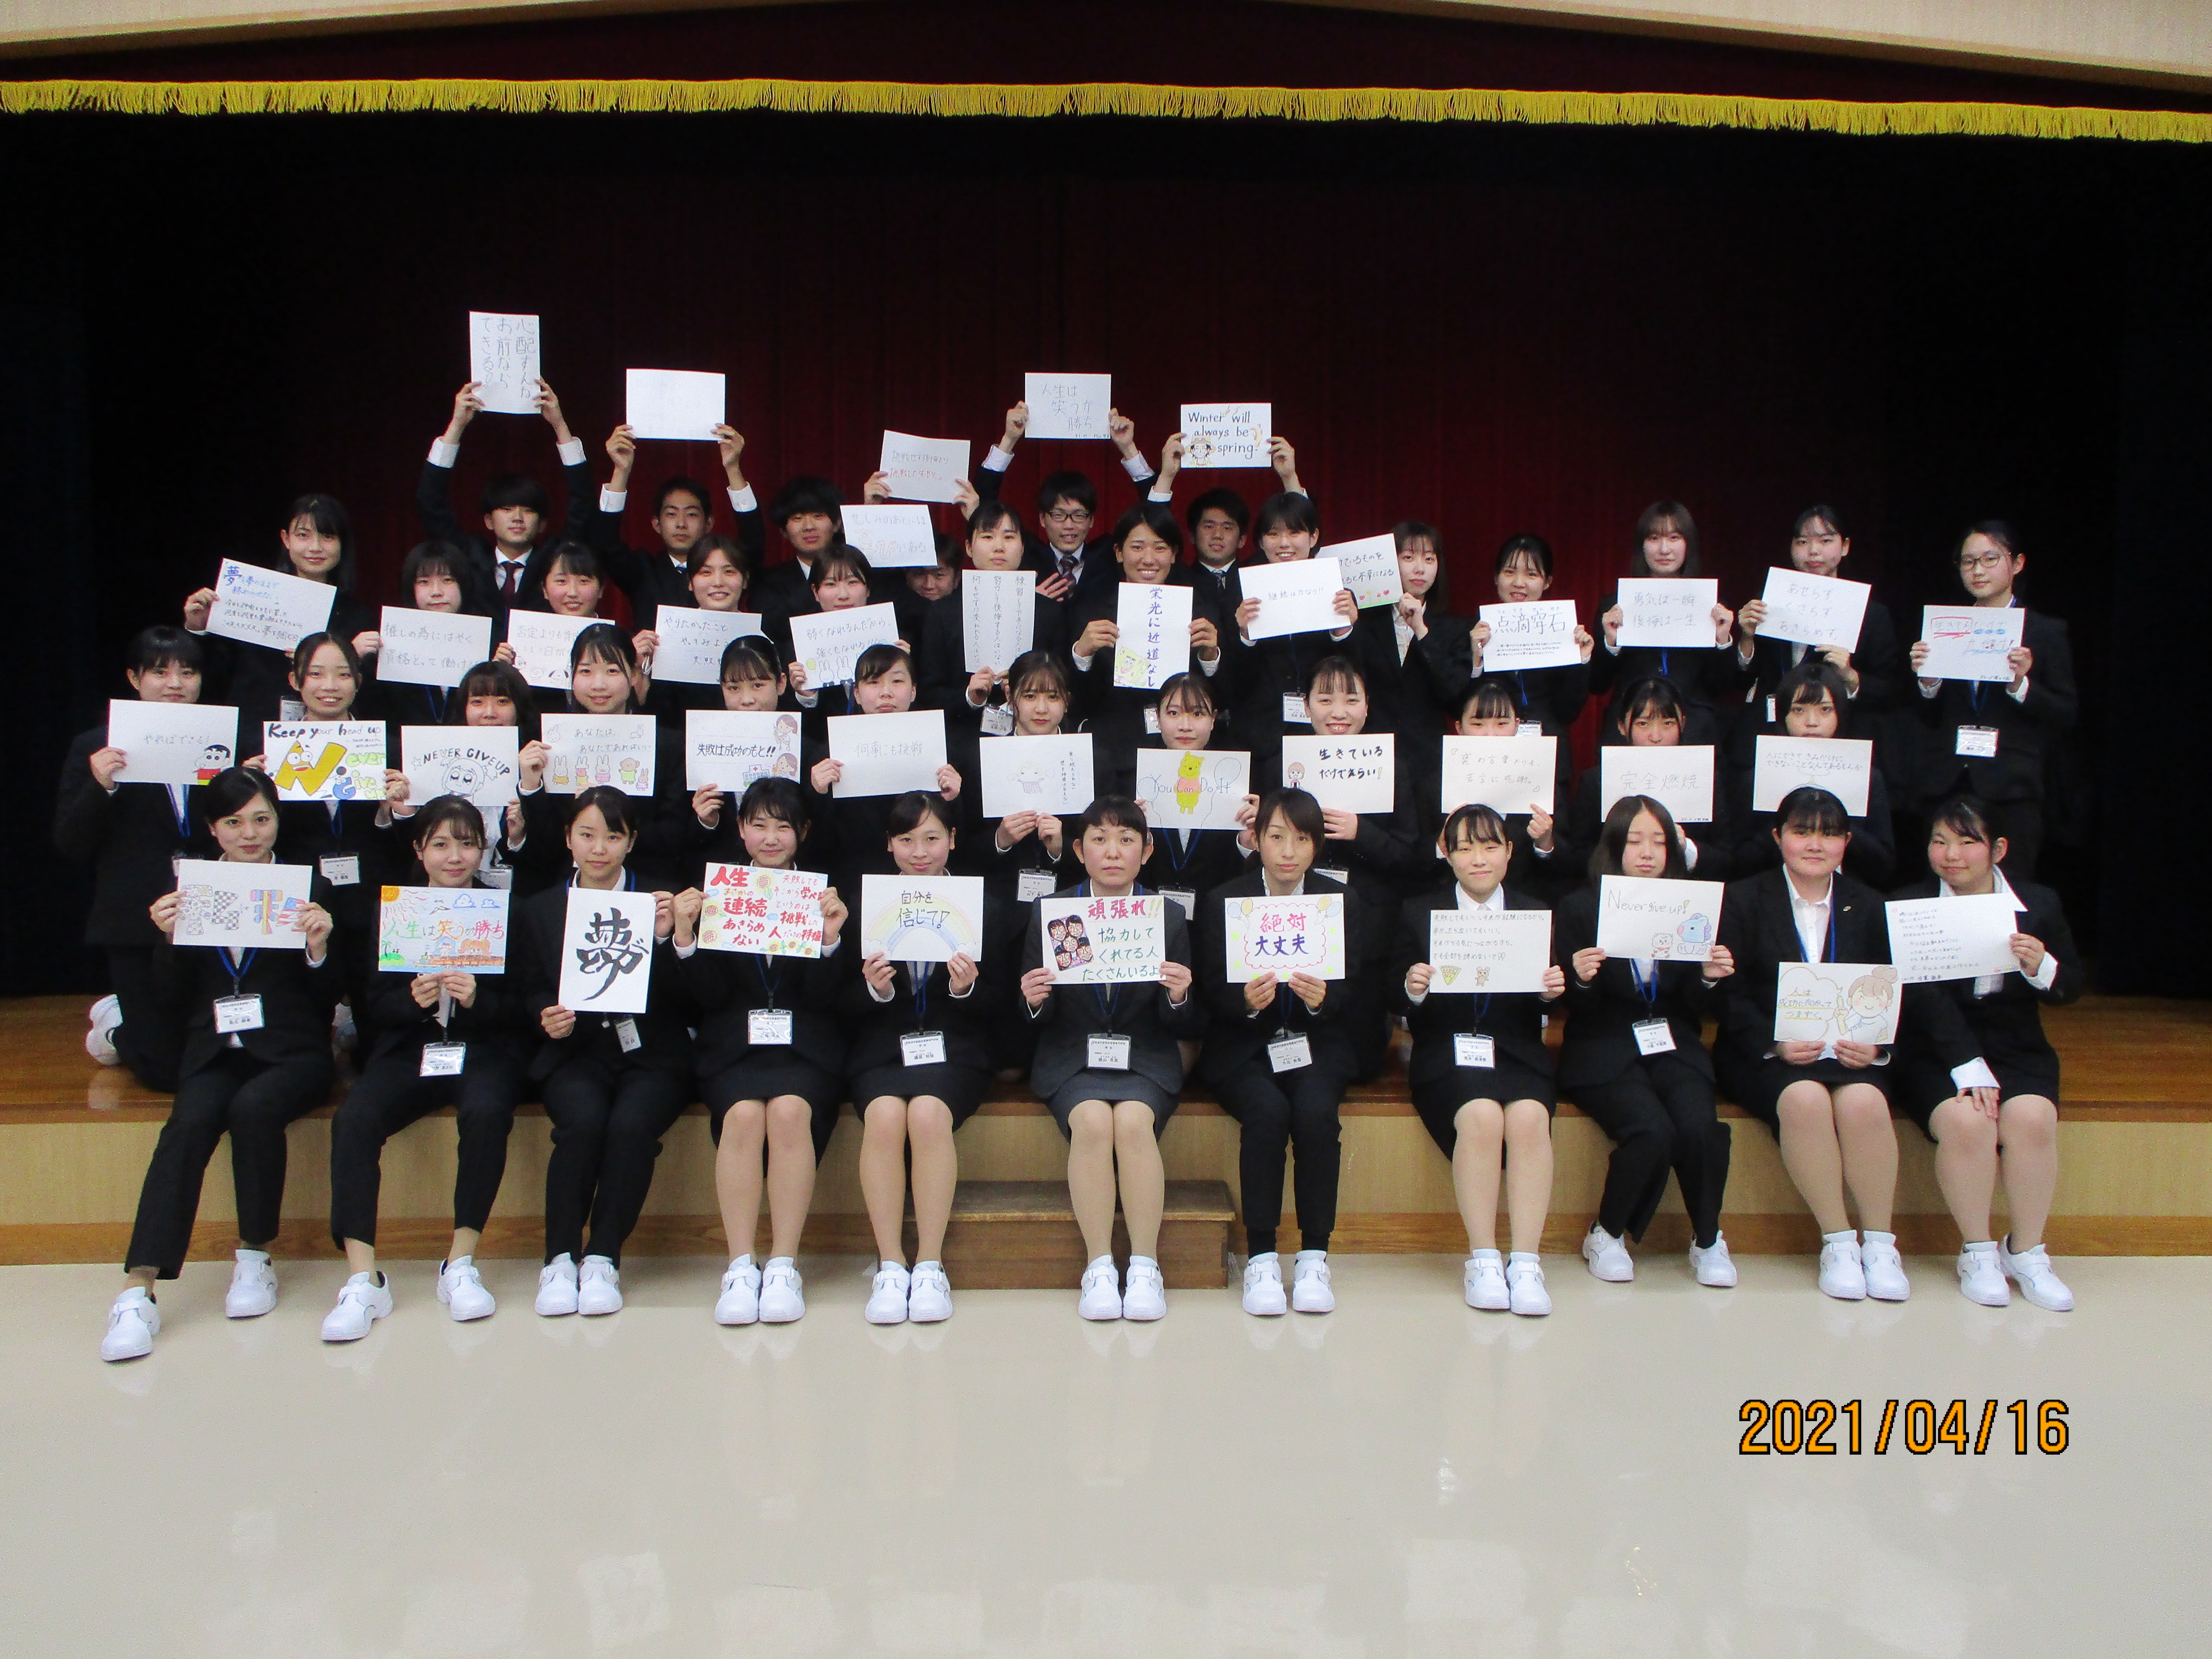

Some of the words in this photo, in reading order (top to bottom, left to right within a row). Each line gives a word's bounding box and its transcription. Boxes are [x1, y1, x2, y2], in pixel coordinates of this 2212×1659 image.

[497, 318, 512, 389] お前なら
[1042, 383, 1077, 398] 人生は
[1068, 417, 1092, 431] 勝ち
[1188, 412, 1224, 423] Winter
[1232, 411, 1250, 423] will
[1194, 425, 1229, 440] always
[1237, 427, 1249, 437] be
[1495, 613, 1565, 635] 点滴穿石
[1147, 587, 1163, 687] 栄光に近道なし
[268, 723, 306, 738] Keep
[310, 728, 333, 739] your
[338, 723, 362, 735] head
[368, 726, 381, 737] up
[423, 748, 461, 764] NEVER
[856, 741, 923, 758] 何事にも挑戦
[1319, 746, 1383, 760] 生きている
[1176, 779, 1194, 793] Can
[1200, 779, 1213, 793] Do
[1620, 771, 1698, 791] 完全燃焼
[711, 866, 750, 887] 人生
[901, 890, 933, 904] 自分を
[1607, 889, 1645, 912] Never
[1647, 902, 1666, 914] give
[723, 897, 768, 918] 連続
[1088, 898, 1163, 921] 頑張れ!!
[385, 919, 504, 941] 人生は笑うが勝ち
[1260, 912, 1307, 933] 絶対
[732, 933, 759, 946] ない
[1097, 927, 1154, 944] 協力して
[1255, 933, 1310, 957] 大丈夫
[1099, 946, 1160, 962] くれてる人
